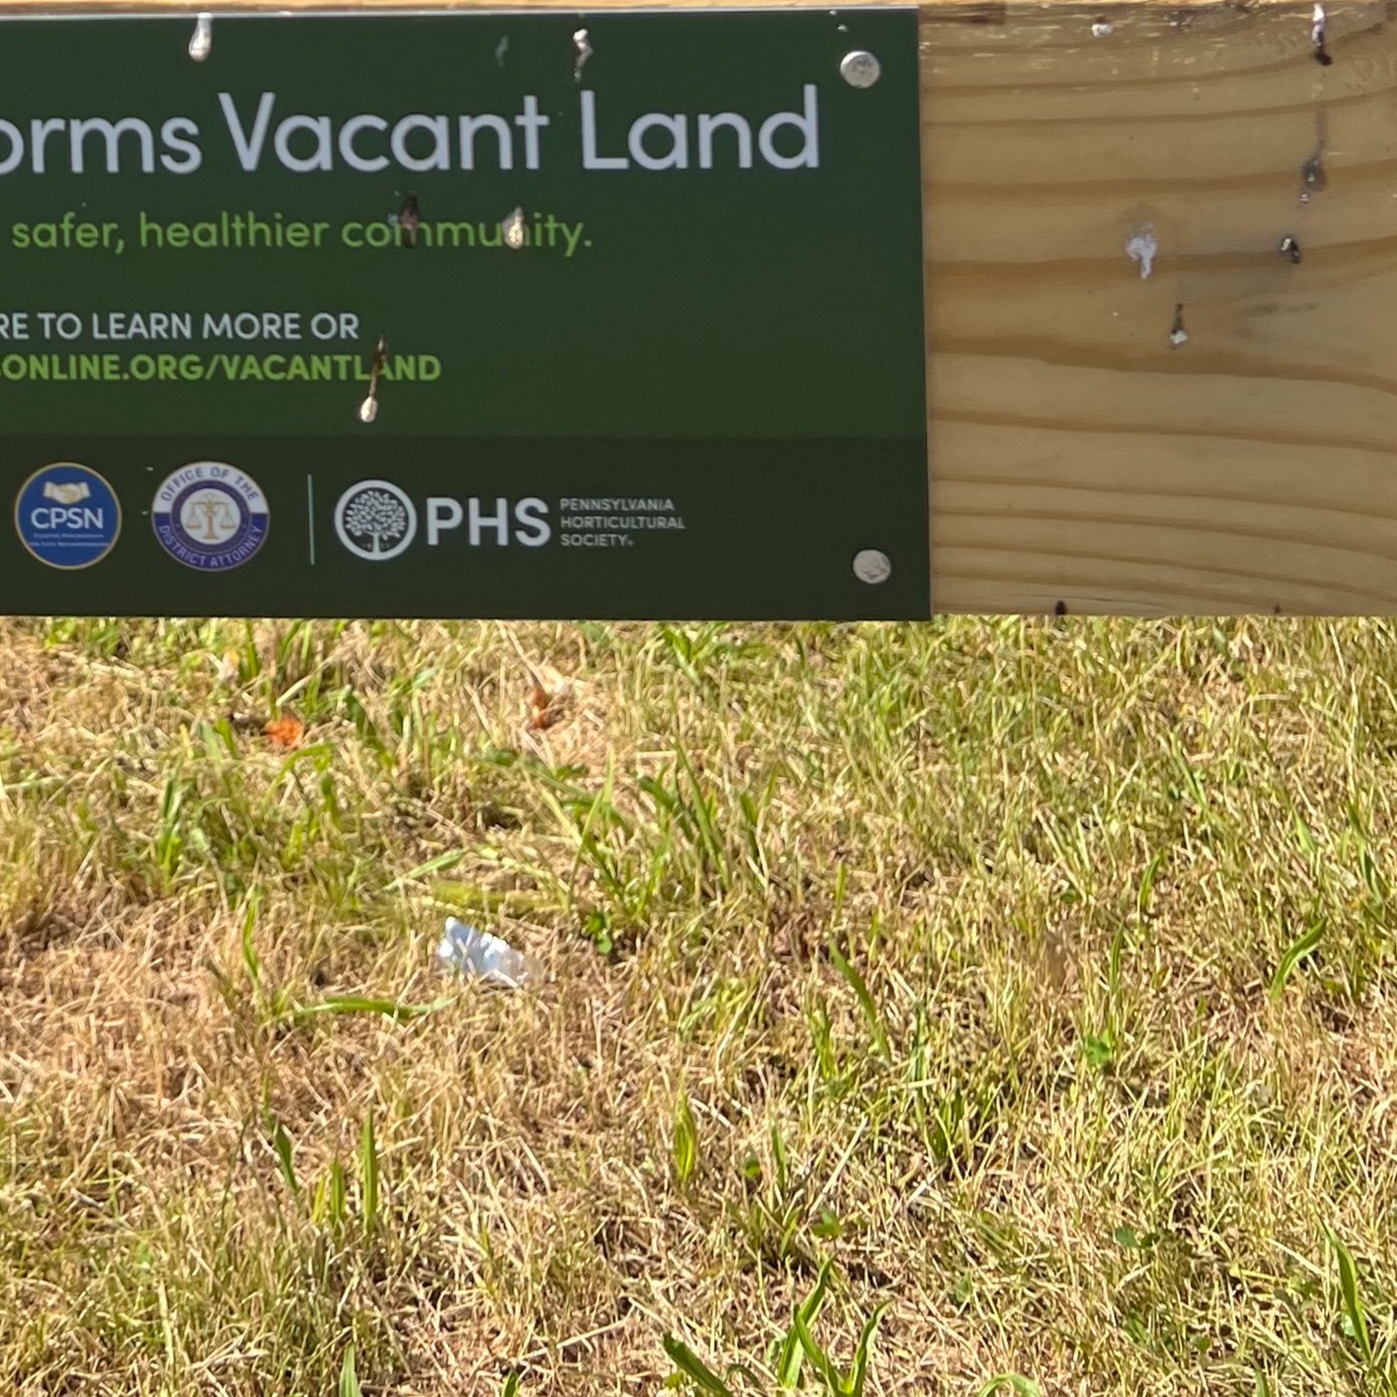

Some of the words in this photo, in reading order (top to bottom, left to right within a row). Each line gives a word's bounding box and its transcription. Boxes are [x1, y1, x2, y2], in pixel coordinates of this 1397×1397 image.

[217, 91, 551, 172] Vacant
[580, 84, 819, 171] Land
[12, 211, 125, 254] safer,
[139, 210, 330, 248] healthier
[341, 211, 593, 258] commuity.
[37, 312, 82, 340] TO
[92, 312, 192, 340] LEARN
[202, 312, 302, 340] MORE
[310, 312, 359, 340] OR
[160, 466, 204, 502] OFFICE
[210, 465, 230, 478] OF
[233, 475, 260, 501] THE
[30, 506, 104, 529] CPSN
[426, 497, 552, 547] PHS
[560, 497, 675, 511] PENNSYLVANIA
[560, 515, 686, 529] HORTICULTURAL
[158, 524, 207, 567] DISTRICT
[209, 524, 263, 568] ATTORNEY
